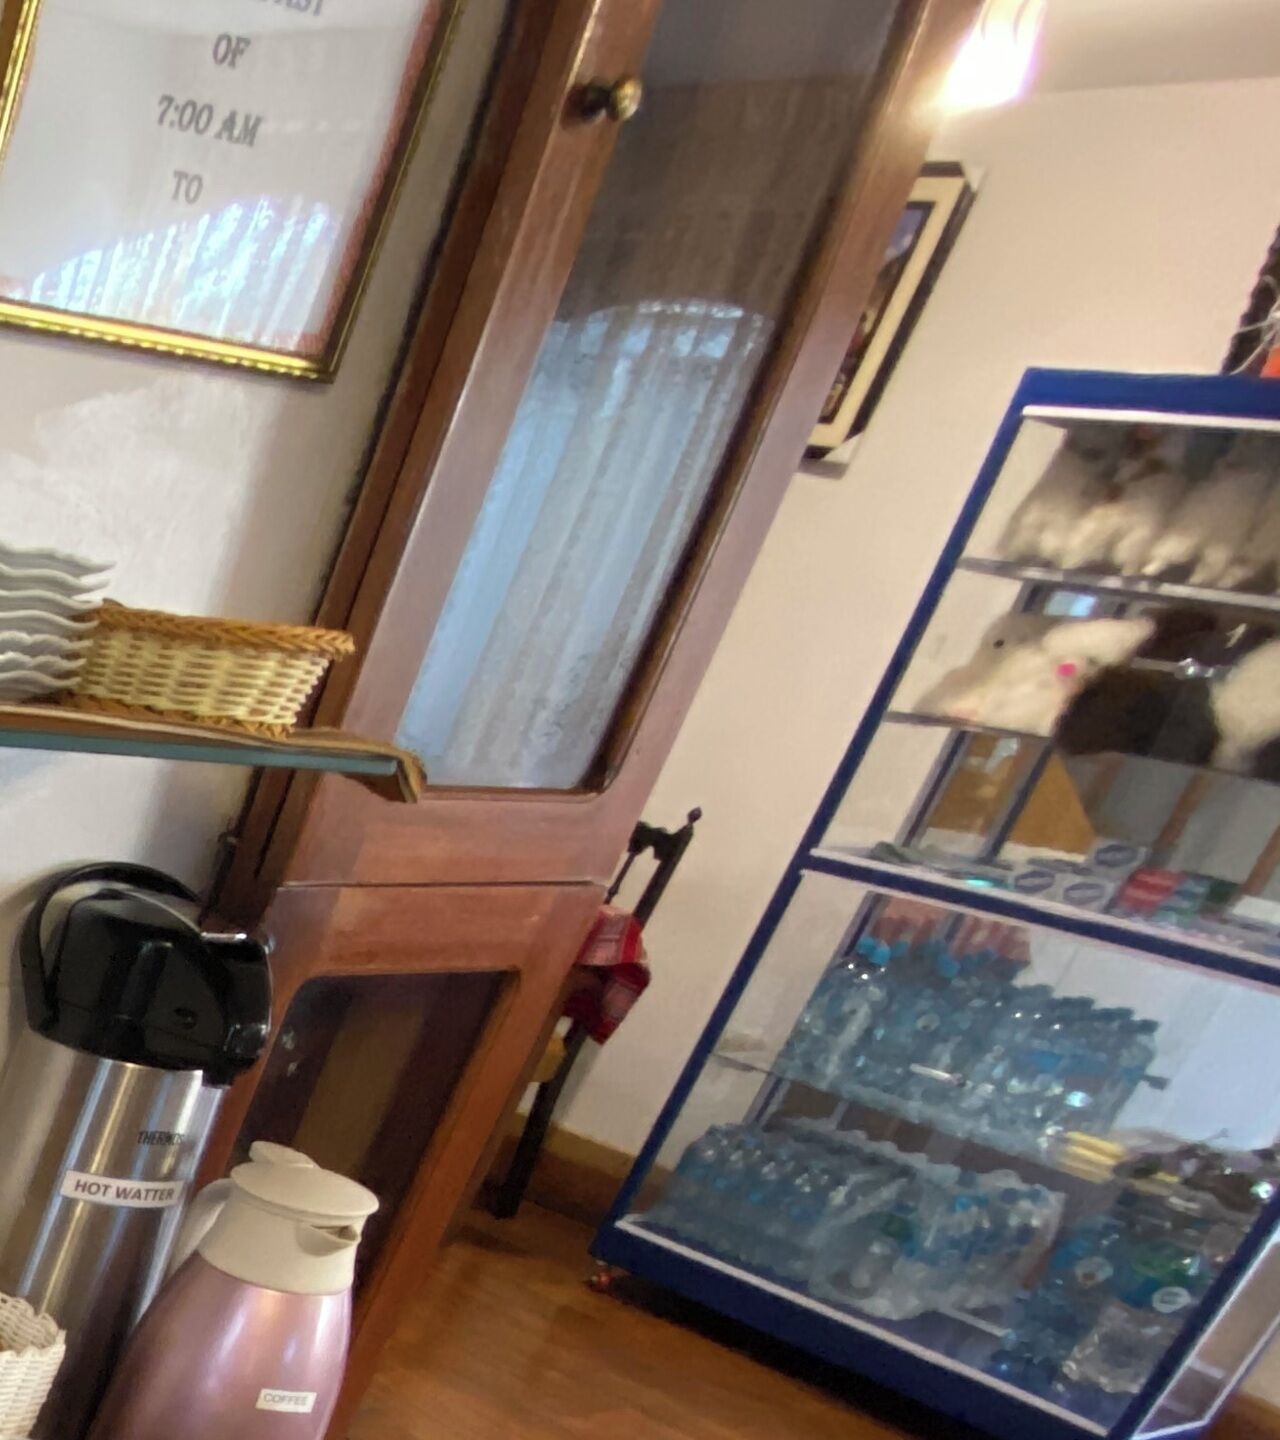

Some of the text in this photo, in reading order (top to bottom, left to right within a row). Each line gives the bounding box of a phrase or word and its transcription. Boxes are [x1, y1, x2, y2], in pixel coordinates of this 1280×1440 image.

[212, 33, 251, 69] OF
[158, 93, 264, 147] 7:00 AM
[171, 170, 203, 204] TO
[74, 1179, 175, 1201] HOT WATTER
